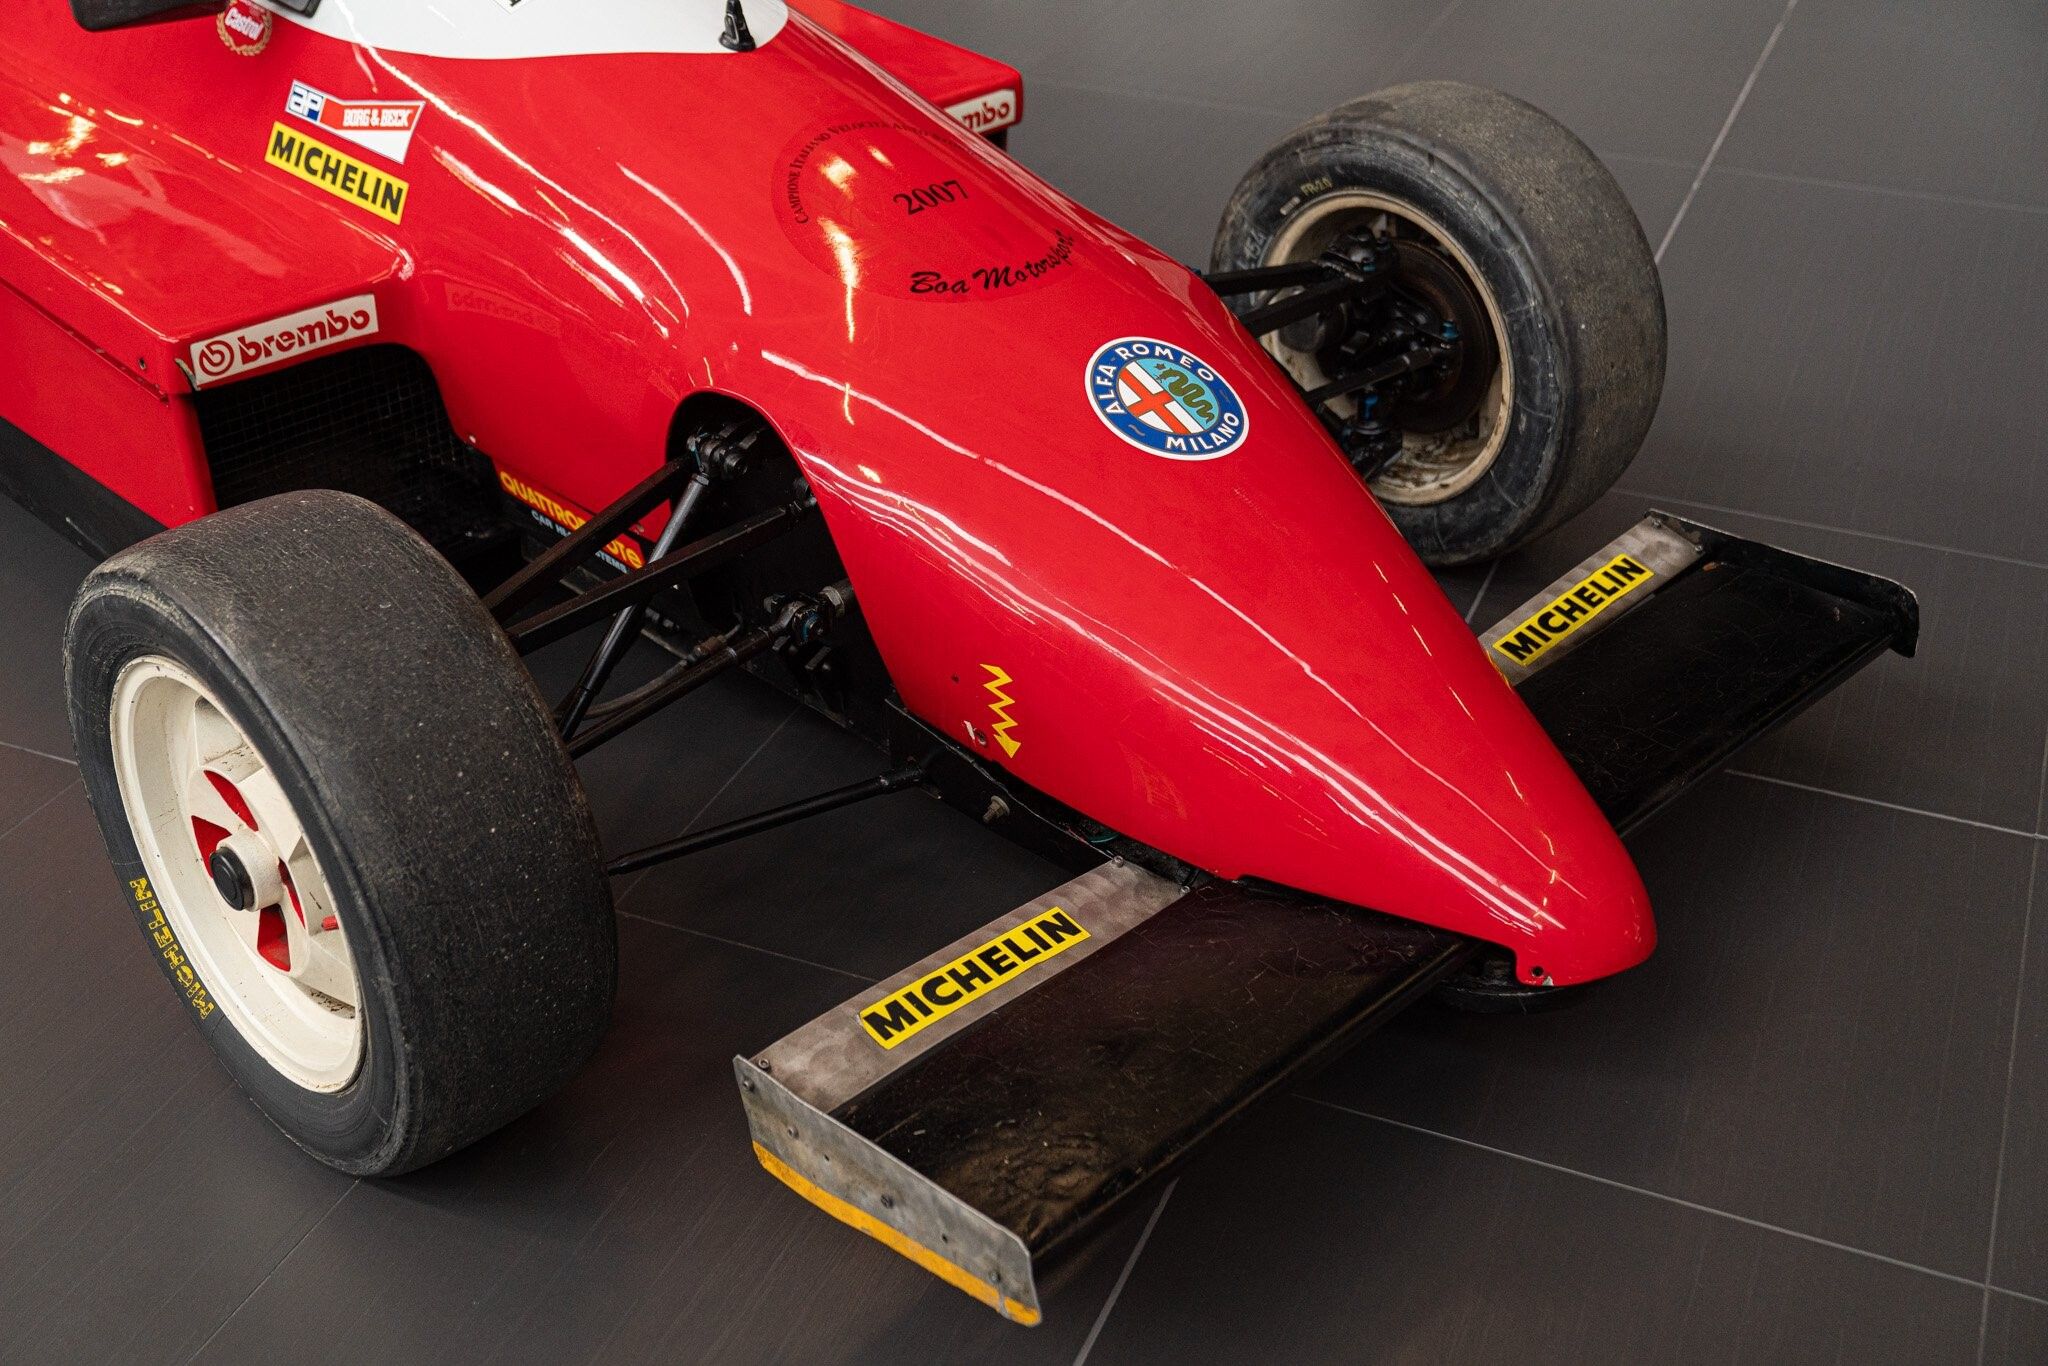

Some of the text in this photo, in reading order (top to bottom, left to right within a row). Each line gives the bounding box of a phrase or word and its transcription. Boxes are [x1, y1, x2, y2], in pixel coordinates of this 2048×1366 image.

[225, 7, 264, 40] Castrol
[343, 108, 413, 128] BORG & BECK
[962, 101, 1010, 129] mbo
[271, 130, 403, 215] MICHELIN
[787, 170, 809, 224] CAMPIONE
[893, 179, 969, 215] 2007
[910, 229, 1075, 293] Boa Motorsport
[237, 309, 370, 366] brembo
[1096, 343, 1215, 415] ALFA ROMEO
[1166, 412, 1240, 451] MILANO
[531, 509, 553, 529] CAR
[1500, 557, 1647, 662] MICHELIN
[129, 877, 215, 1020] MICHELIN
[863, 911, 1082, 1041] MICHELIN
